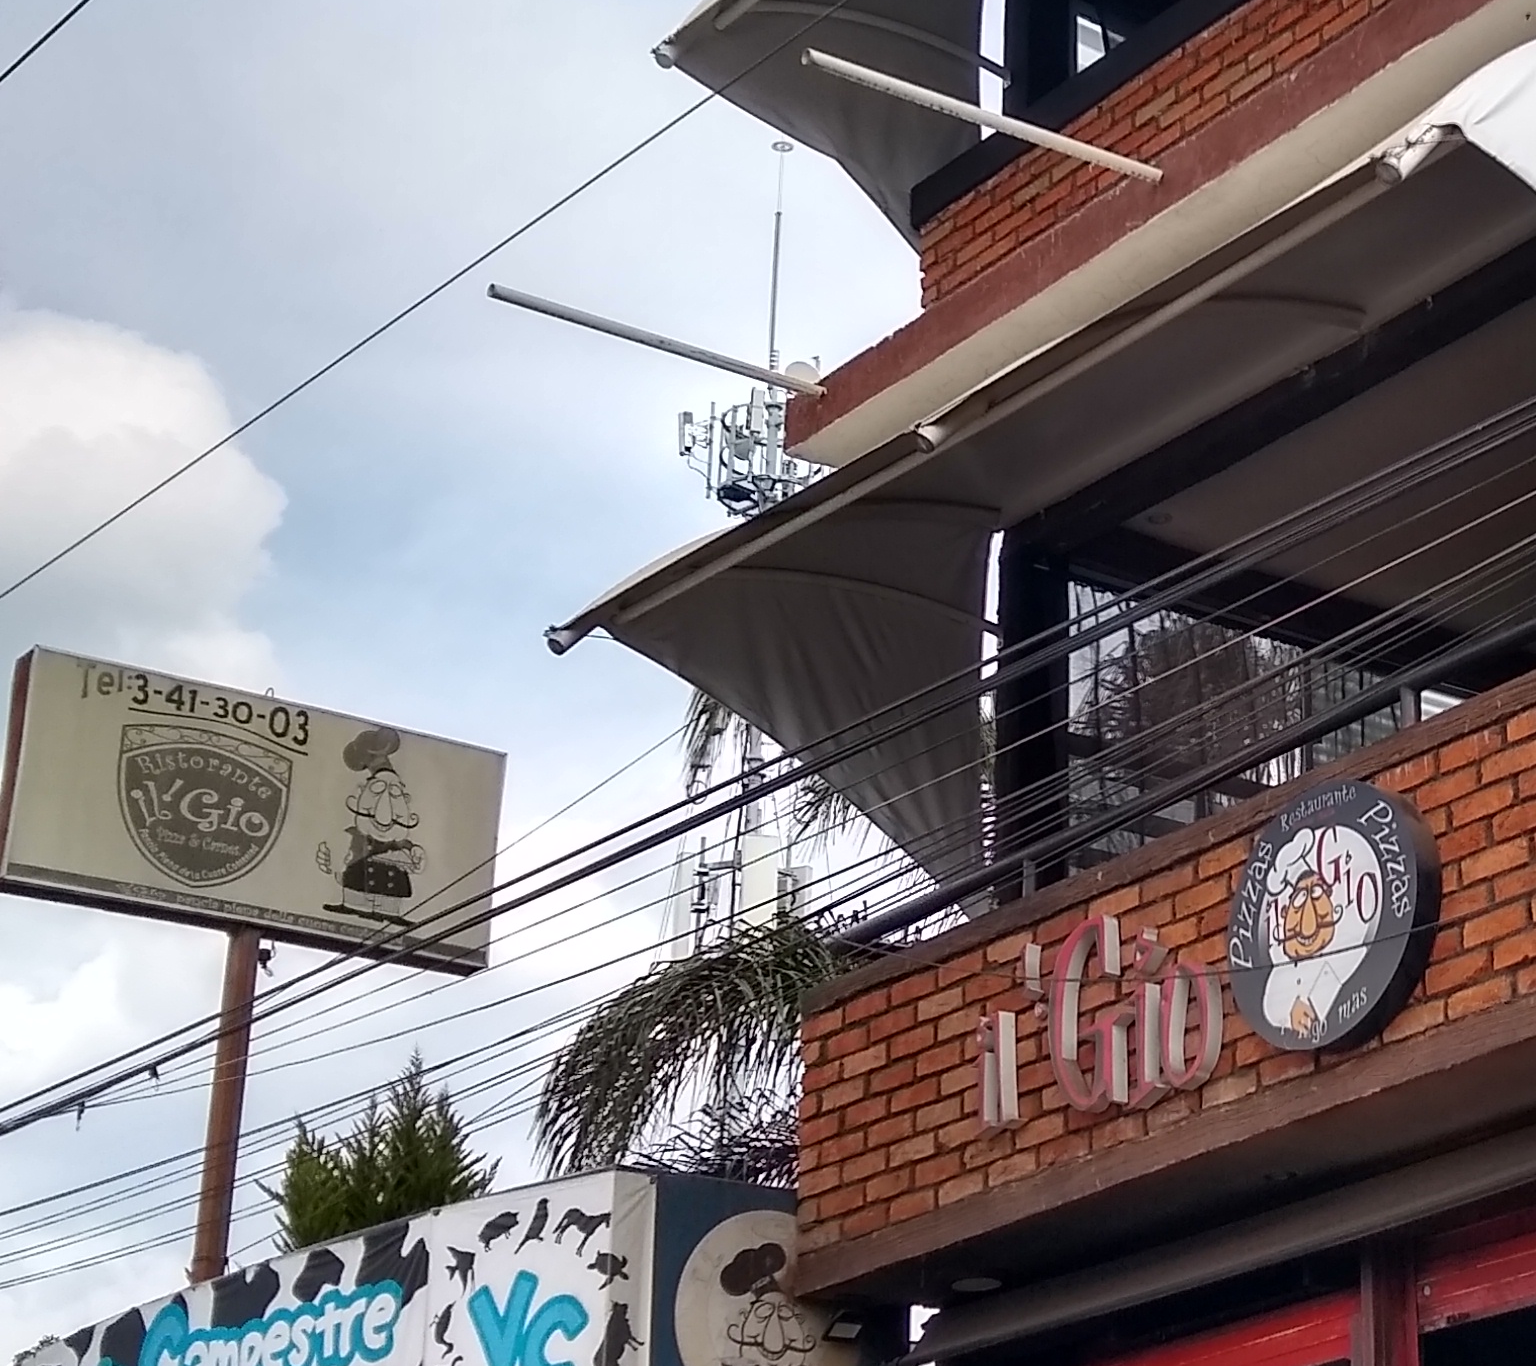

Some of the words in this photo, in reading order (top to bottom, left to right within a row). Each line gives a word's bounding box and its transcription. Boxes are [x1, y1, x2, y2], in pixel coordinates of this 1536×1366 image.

[130, 673, 310, 747] 3-41-30-03
[135, 751, 272, 799] Ristorante
[1280, 784, 1356, 832] Restaurante
[1356, 799, 1412, 919] Pizzas
[1229, 840, 1273, 970] Pizzas
[1338, 987, 1368, 1024] mas
